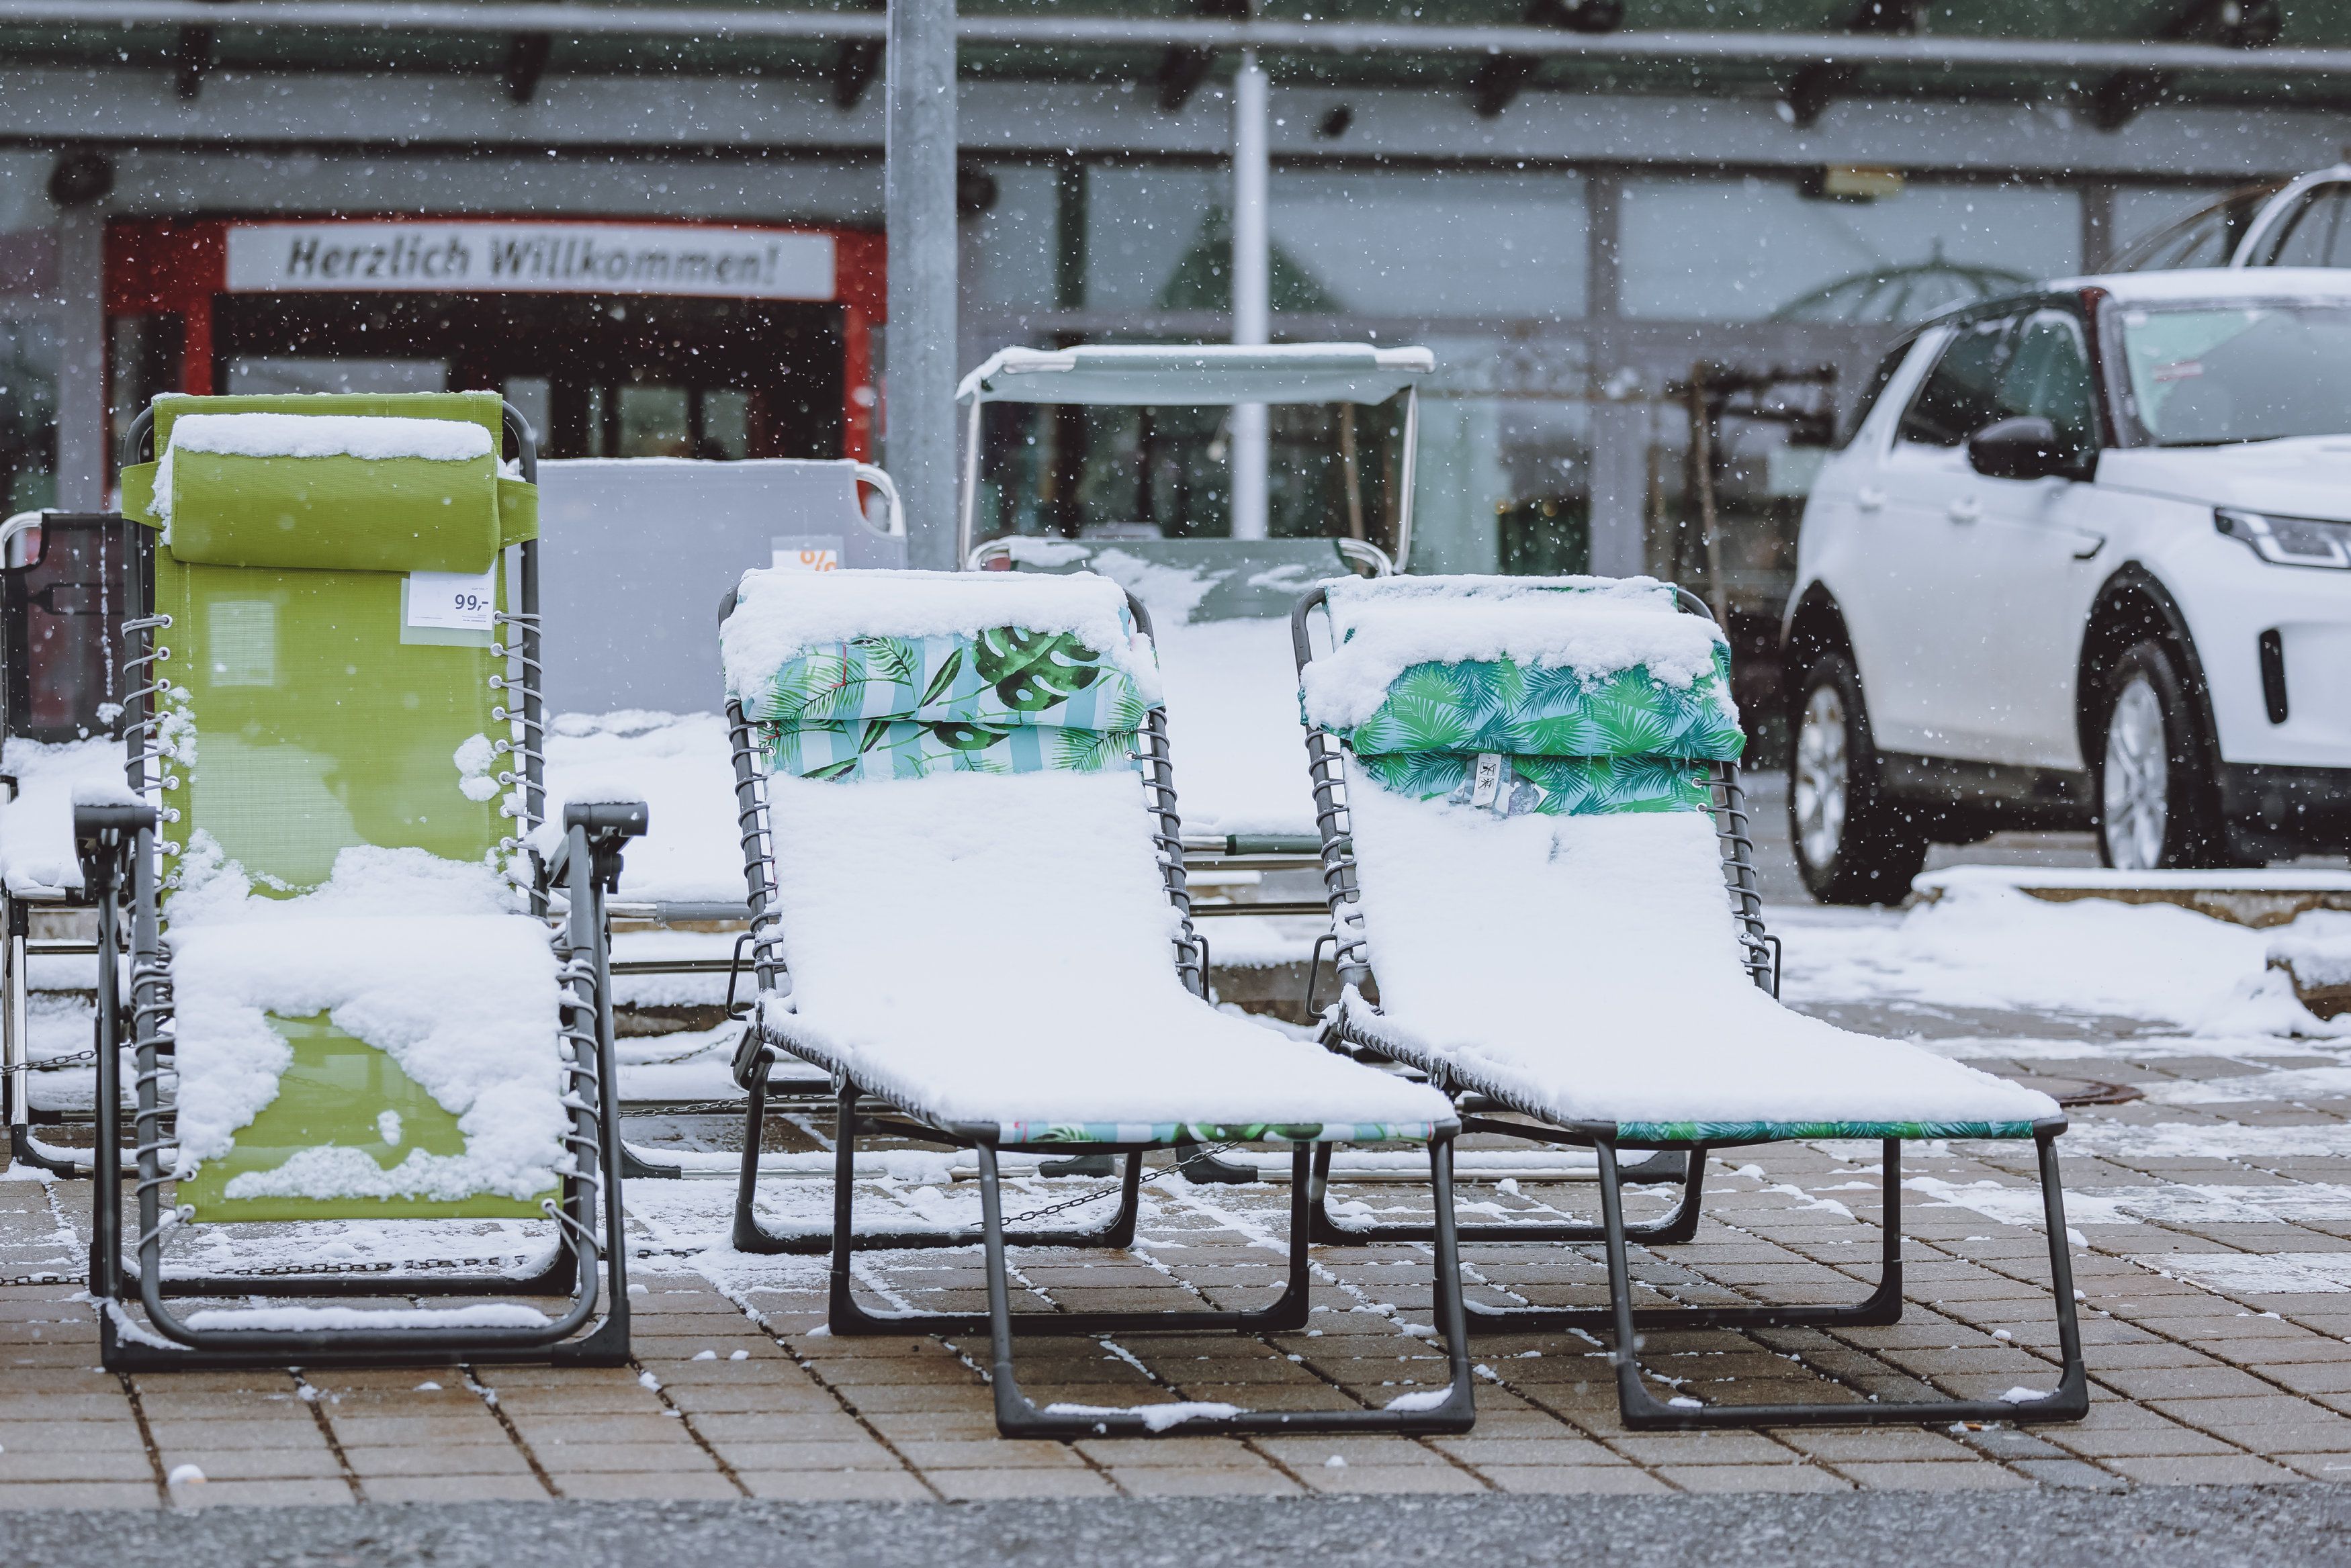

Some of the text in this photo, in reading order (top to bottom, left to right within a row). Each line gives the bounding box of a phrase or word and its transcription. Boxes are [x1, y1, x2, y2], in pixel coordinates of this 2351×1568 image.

[286, 234, 781, 286] Herzlich Willkommen!
[455, 594, 489, 611] 99,-
